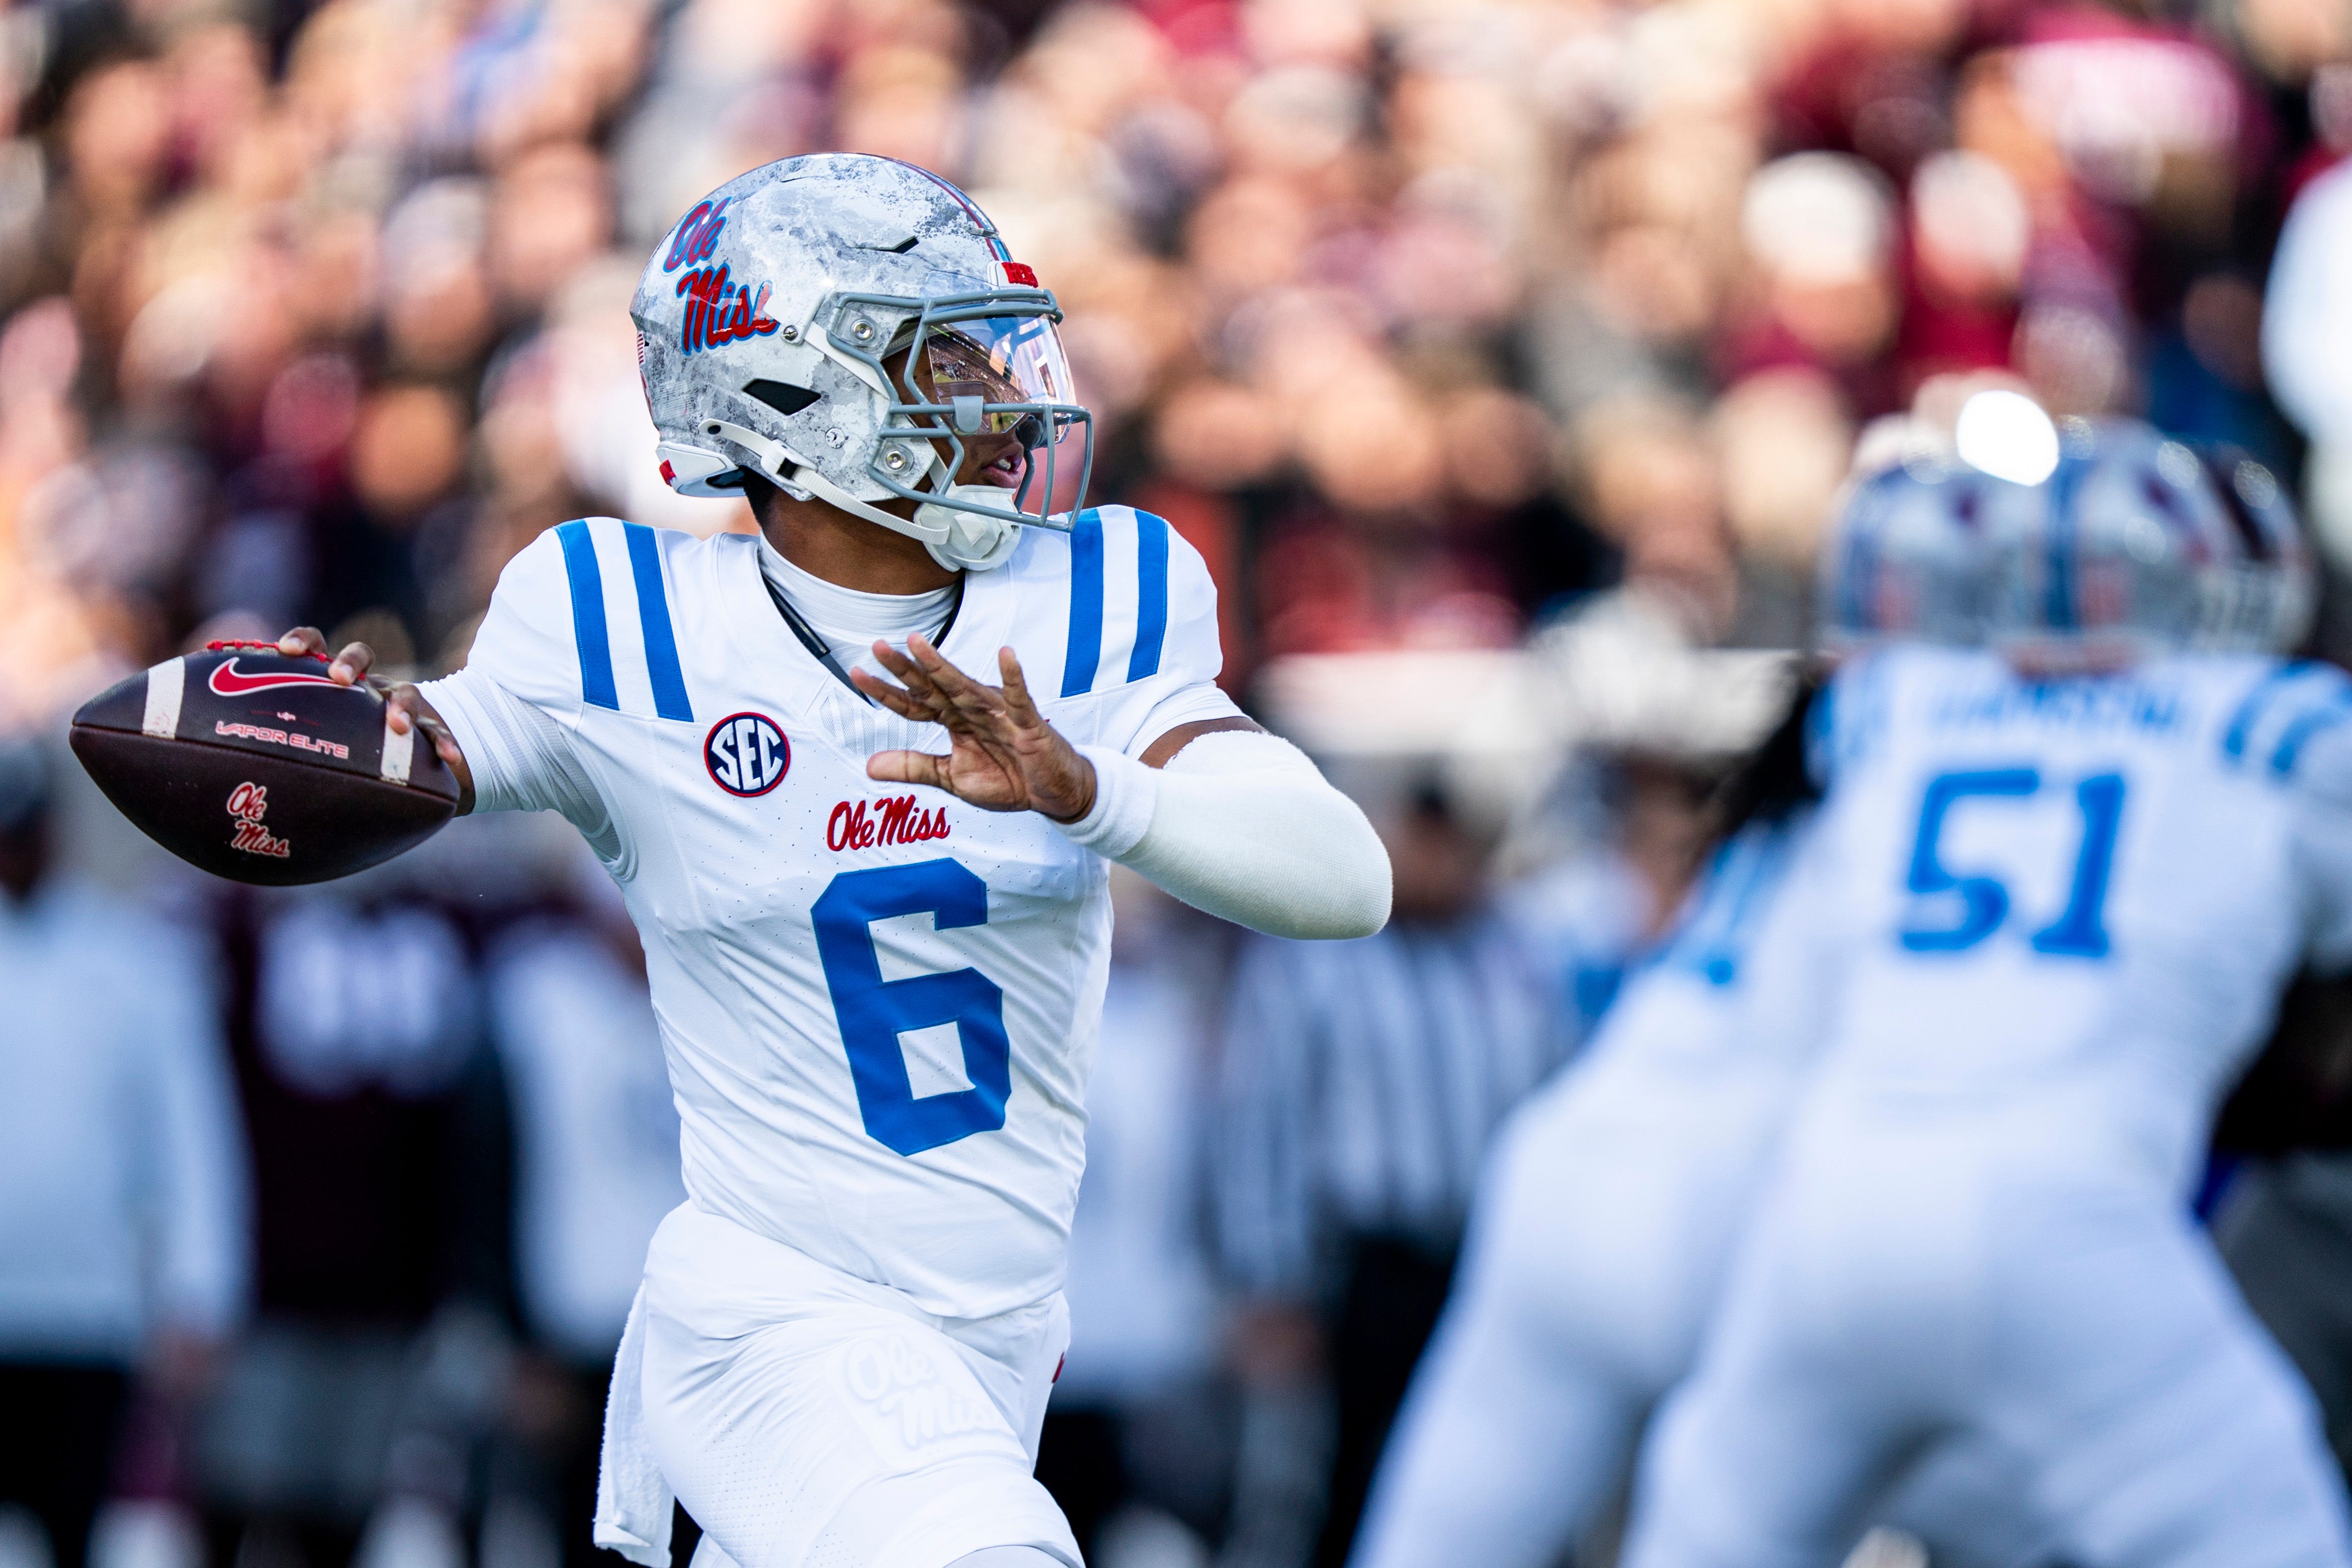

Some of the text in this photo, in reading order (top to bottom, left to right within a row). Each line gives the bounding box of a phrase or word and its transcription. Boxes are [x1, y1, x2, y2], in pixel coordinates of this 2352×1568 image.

[663, 197, 732, 272] Ole
[216, 721, 349, 759] VAPOR ELITE
[711, 718, 783, 791] SEC
[227, 782, 267, 821] Ole
[827, 794, 951, 851] Ole Miss
[231, 819, 290, 857] Miss
[1901, 768, 2125, 956] 51
[810, 857, 1012, 1157] 6
[846, 1334, 936, 1401] Ole
